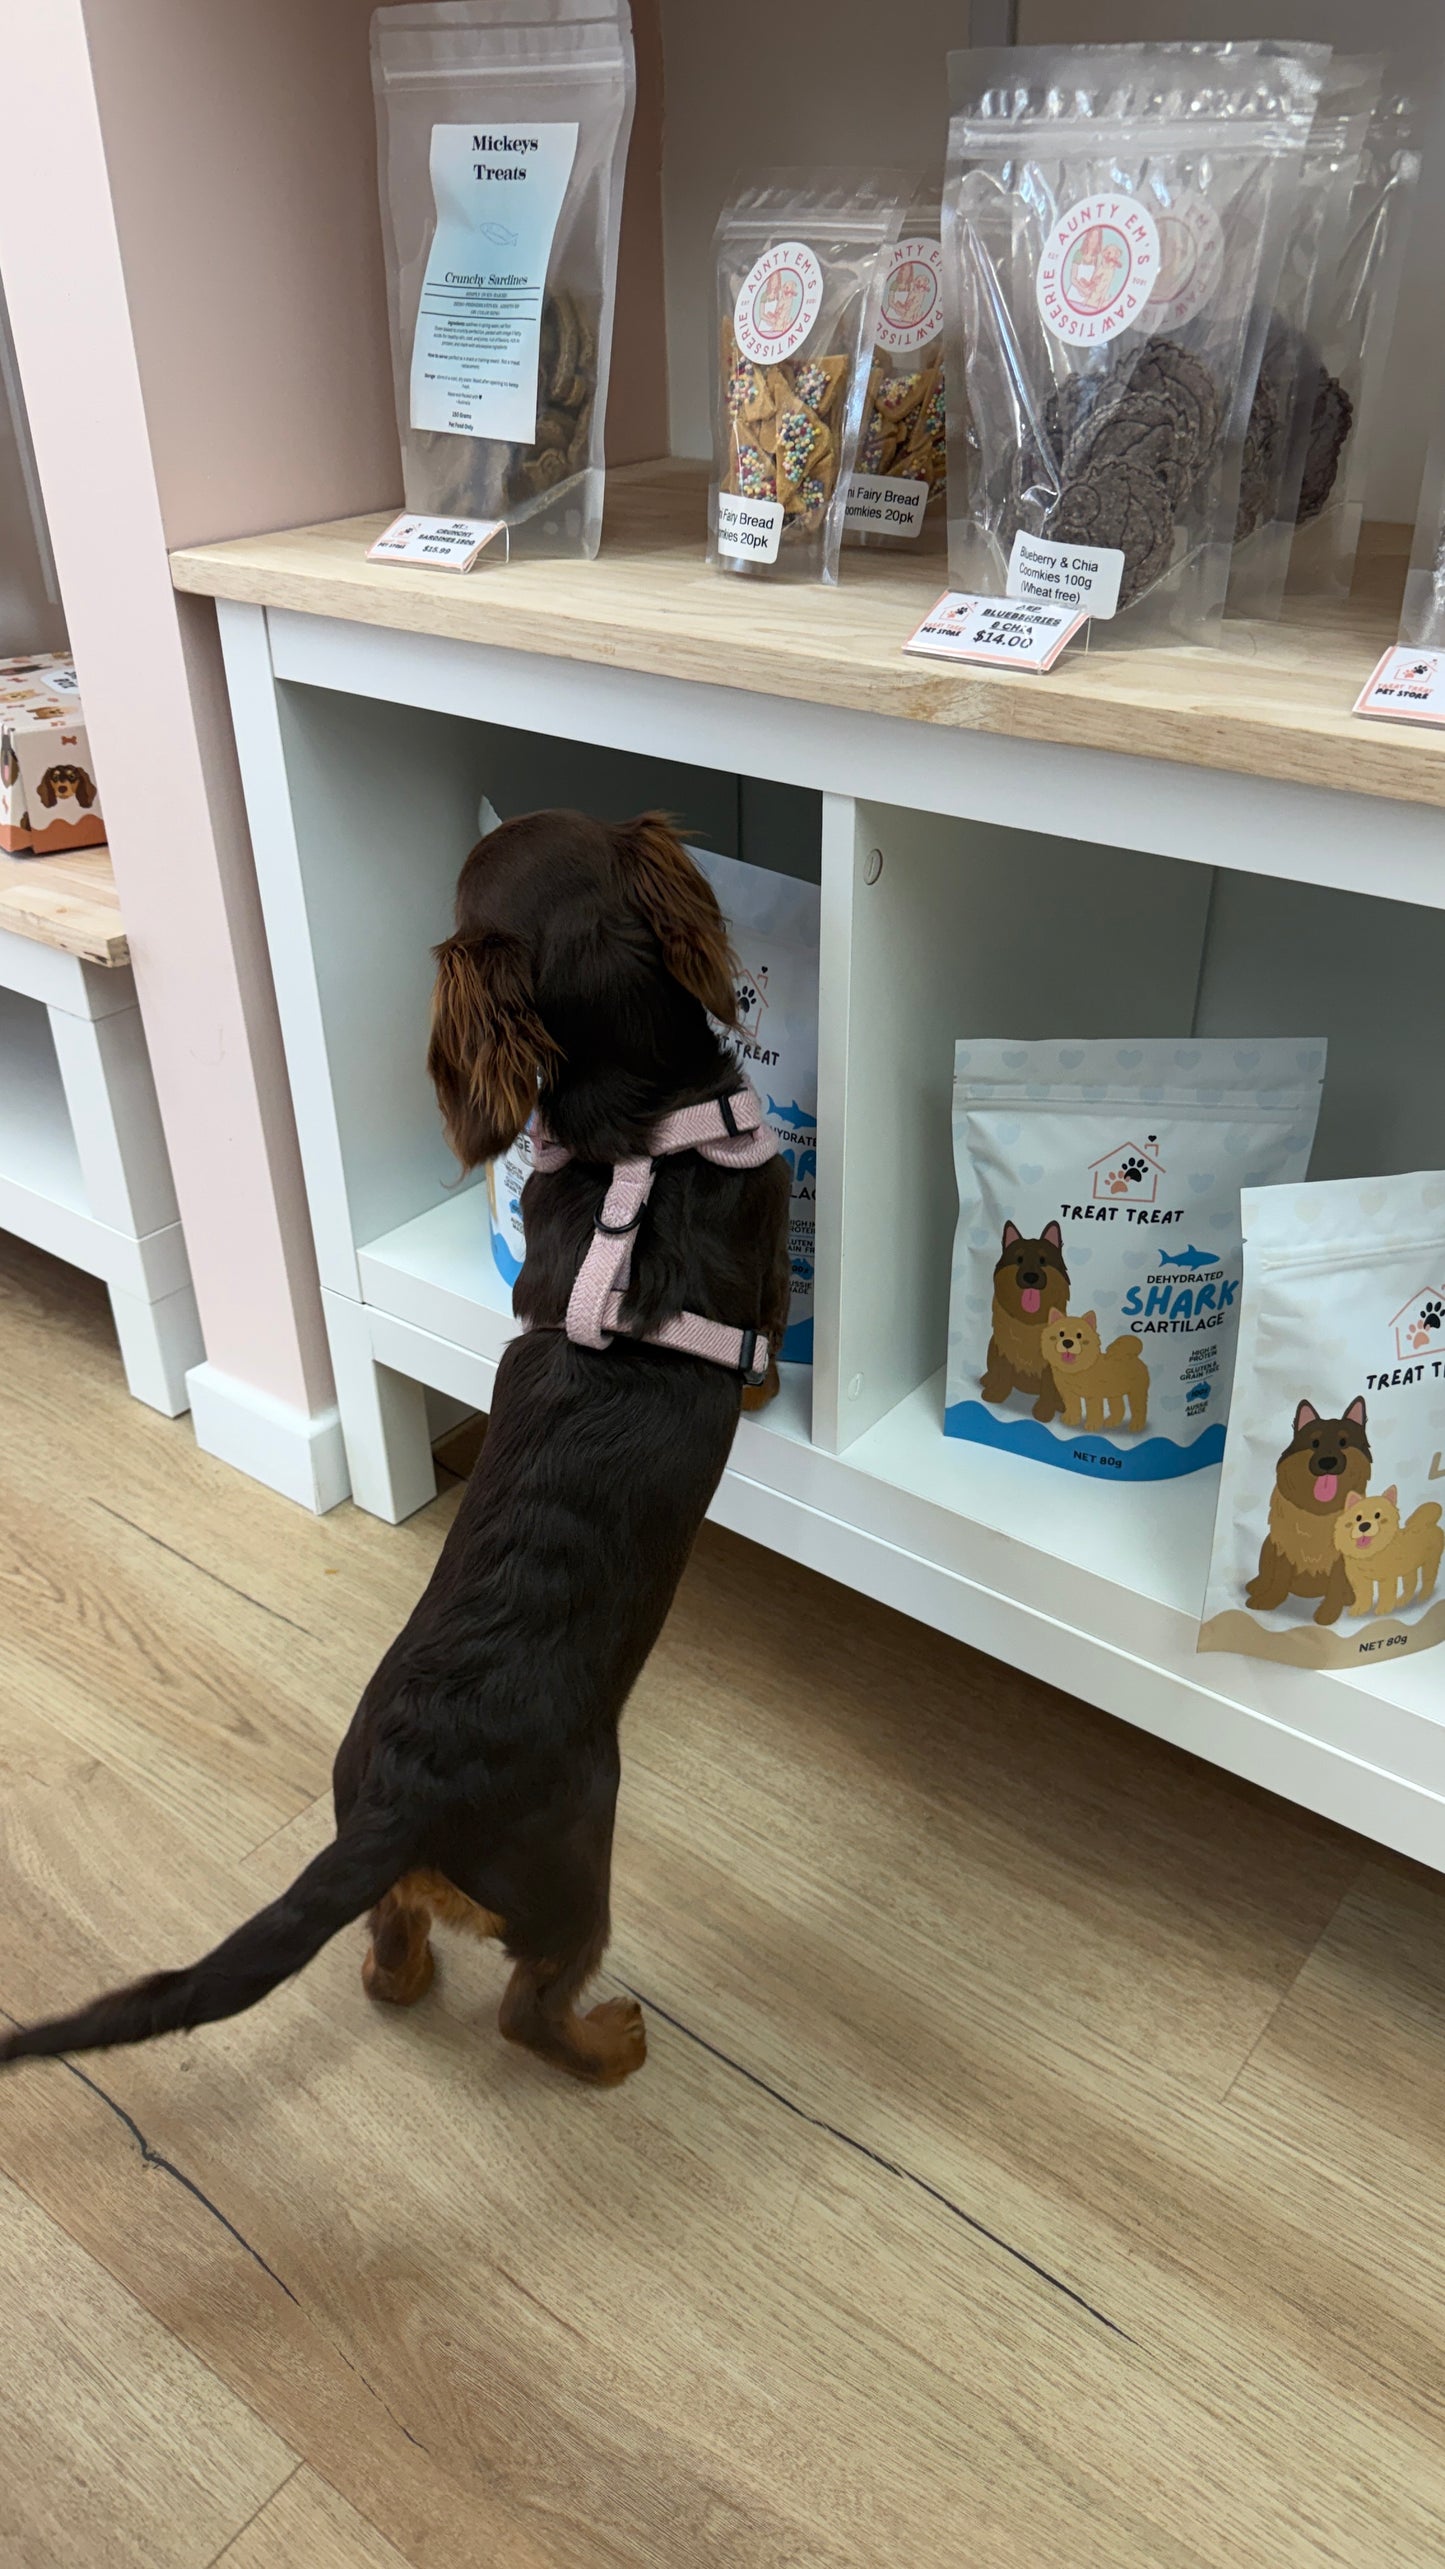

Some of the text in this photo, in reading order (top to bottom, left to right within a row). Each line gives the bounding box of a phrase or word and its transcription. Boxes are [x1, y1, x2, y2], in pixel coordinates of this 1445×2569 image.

[472, 135, 539, 155] Mickeys
[473, 164, 527, 181] Treats
[1058, 204, 1150, 265] AUNTY EM'S
[444, 272, 528, 287] Crunchy Sardines
[747, 250, 817, 293] AUNTY EM'S
[1043, 269, 1137, 337] PAWTISSERIE
[738, 312, 811, 357] PAWTISSERIE
[857, 487, 882, 503] Fairy
[884, 490, 920, 506] Bread
[739, 512, 774, 530] Bread
[845, 505, 914, 524] oomkies 20pk
[418, 534, 456, 543] SARDINES
[436, 529, 474, 537] CRUNCHY
[740, 532, 768, 549] 20pk
[422, 545, 452, 555] $15.99
[1020, 546, 1098, 572] Blueberry & Chia
[1019, 562, 1092, 590] Coomkies 100g
[1020, 580, 1081, 604] (Wheat free)
[981, 608, 1062, 626] BLUEBERRIES
[936, 629, 961, 637] STORE
[973, 629, 1034, 648] $14.00
[1397, 690, 1429, 699] STORE
[735, 1040, 780, 1066] TREAT
[790, 1219, 808, 1227] IGH
[1061, 1204, 1184, 1225] TREAT TREAT
[789, 1280, 813, 1288] USSIE
[1147, 1270, 1224, 1284] DEHYDRATED
[1121, 1280, 1239, 1320] SHARK
[1130, 1312, 1225, 1333] CARTILAGE
[1189, 1350, 1217, 1362] PROTEIN
[1192, 1347, 1209, 1356] HIGH
[1180, 1365, 1220, 1381] GRAIN FREE
[1185, 1362, 1213, 1374] GLUTEN
[1366, 1365, 1424, 1390] TREAT
[1073, 1450, 1122, 1469] NET 80g
[1359, 1635, 1408, 1653] NET 80g
